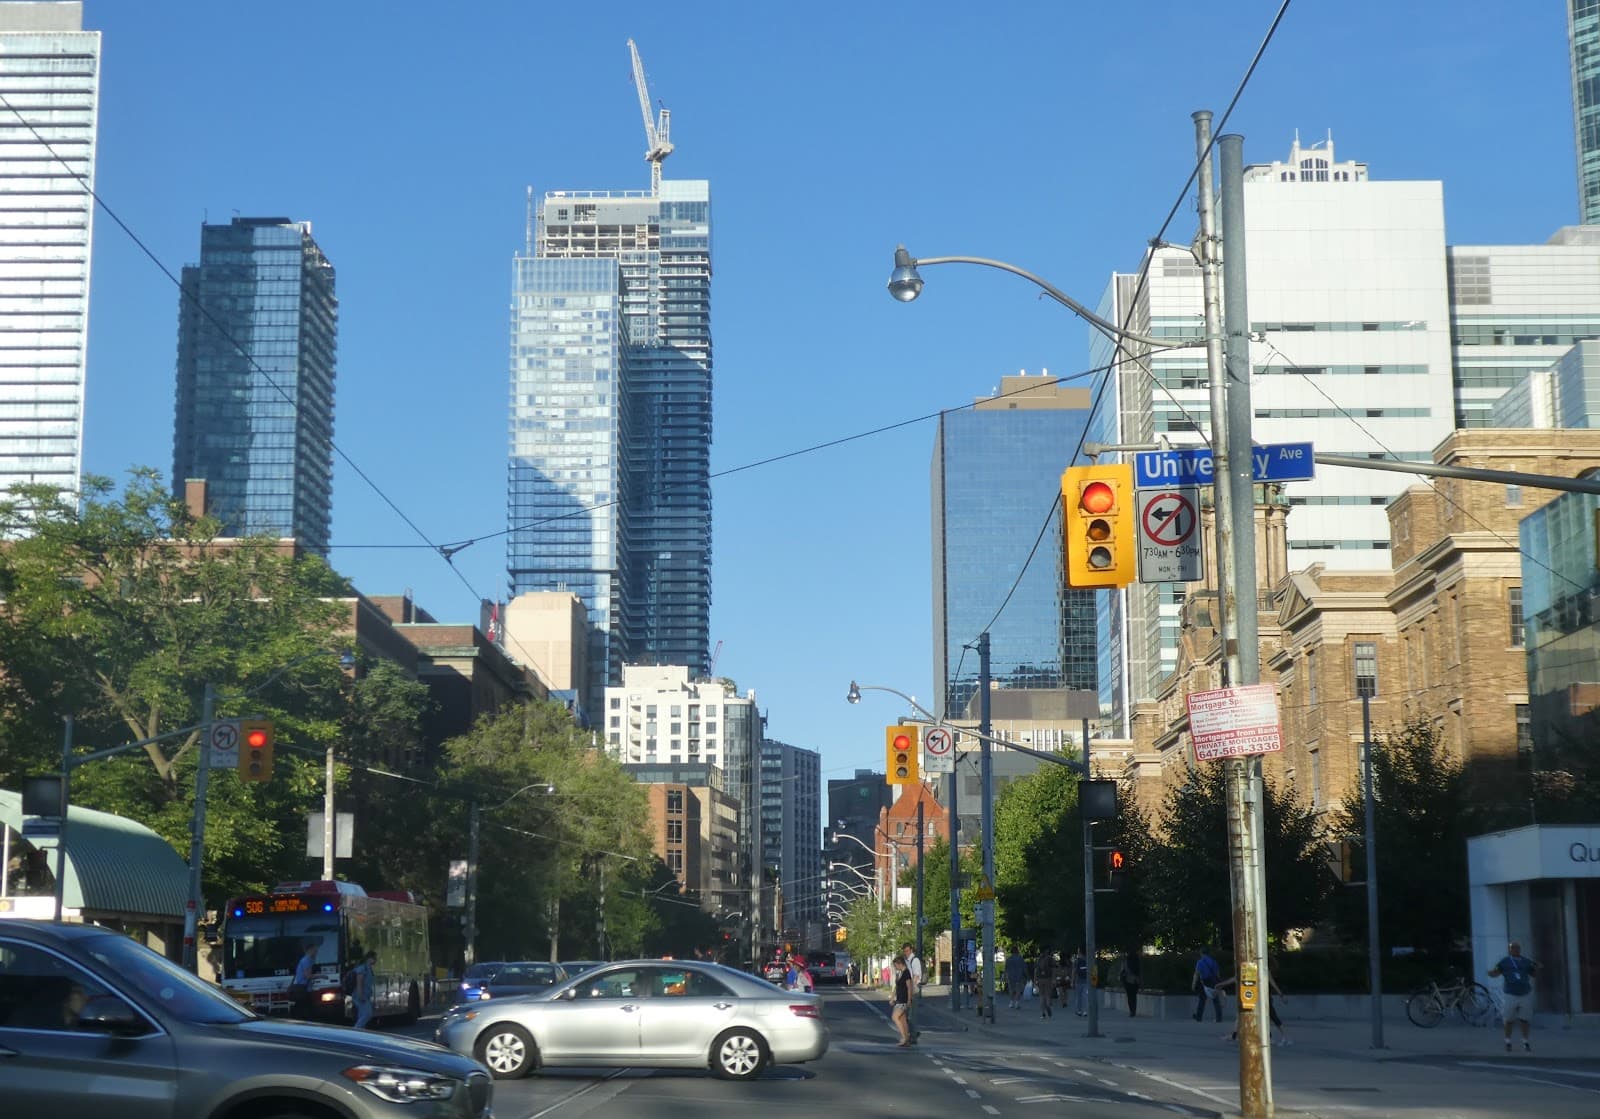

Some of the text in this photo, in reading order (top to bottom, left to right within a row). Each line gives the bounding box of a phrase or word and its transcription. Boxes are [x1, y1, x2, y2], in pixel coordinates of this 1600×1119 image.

[1145, 447, 1303, 478] Univey Ave
[1191, 701, 1226, 711] Mortgage
[1194, 732, 1235, 743] Mortgages
[1237, 730, 1256, 738] from
[1197, 740, 1227, 750] PRIVATE
[1199, 742, 1279, 758] 647-568-3336
[246, 901, 263, 914] 506
